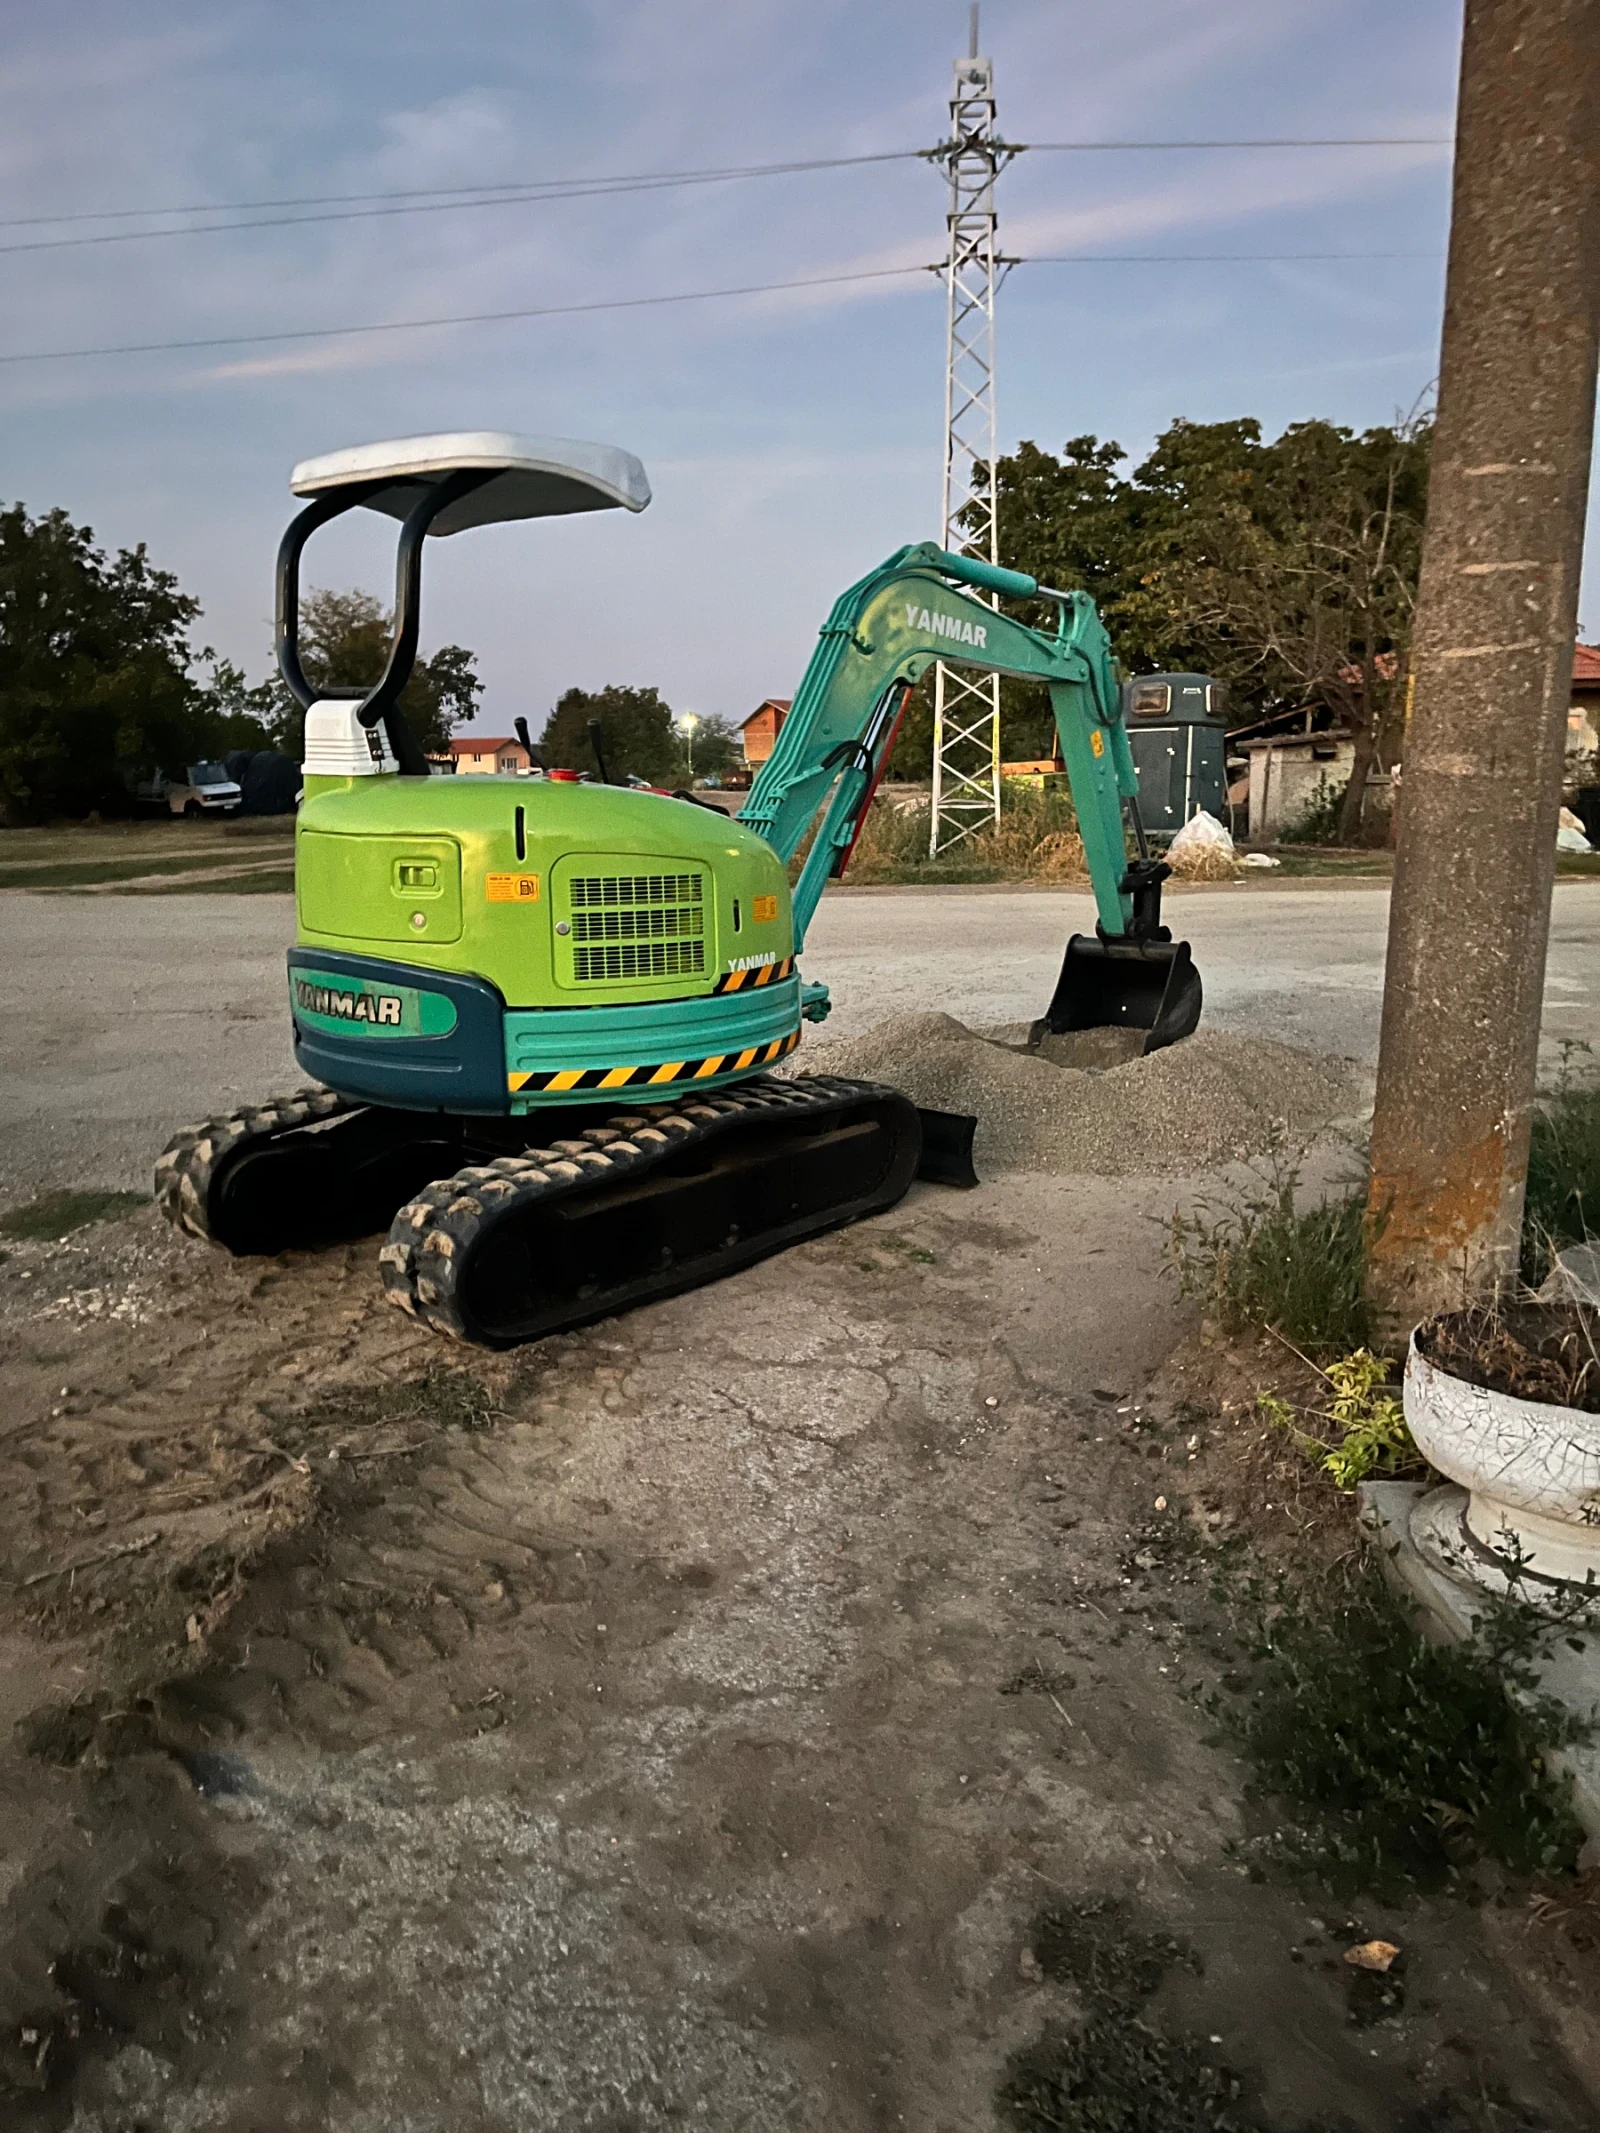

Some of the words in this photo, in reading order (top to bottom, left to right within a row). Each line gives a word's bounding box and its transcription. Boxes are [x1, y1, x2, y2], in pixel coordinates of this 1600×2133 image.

[905, 603, 987, 649] YANMAR
[728, 951, 776, 973] YANMAR
[295, 978, 401, 1025] YANMAR
